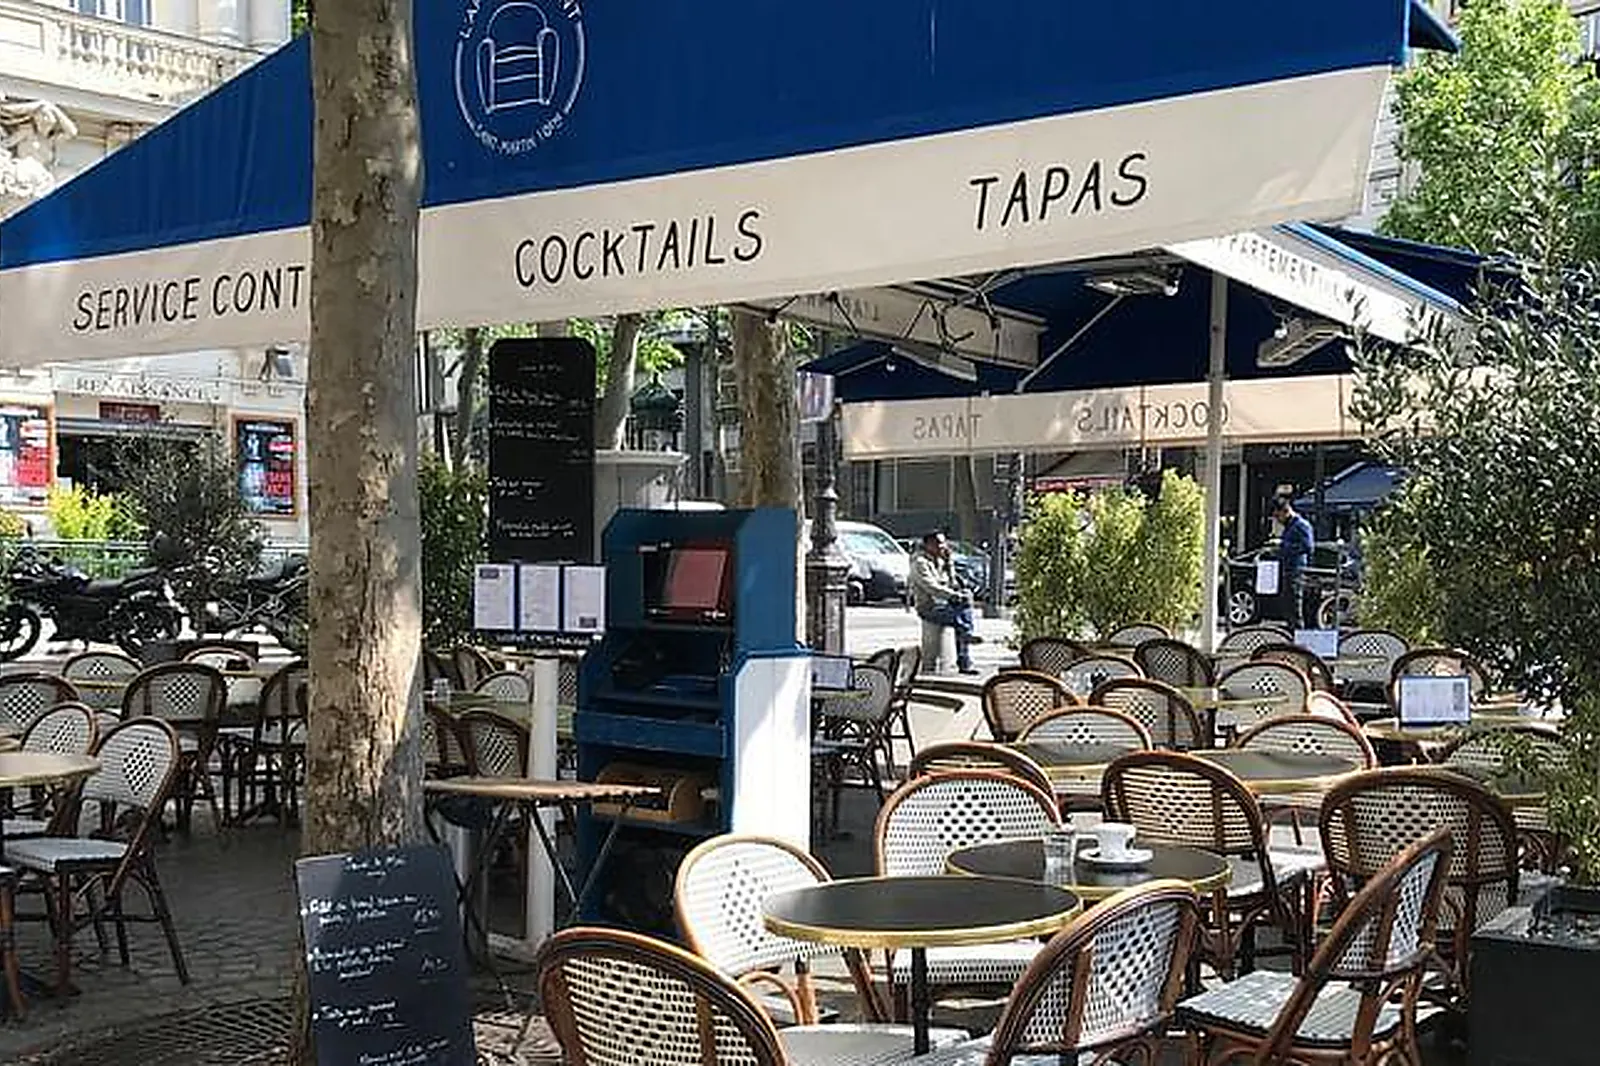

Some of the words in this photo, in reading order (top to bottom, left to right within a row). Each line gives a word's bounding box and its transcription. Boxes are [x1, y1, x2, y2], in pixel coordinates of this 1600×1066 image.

[970, 153, 1146, 230] TAPAS
[515, 211, 762, 287] COCKTAILS
[73, 278, 201, 331] SERVICE
[213, 265, 305, 316] CONT
